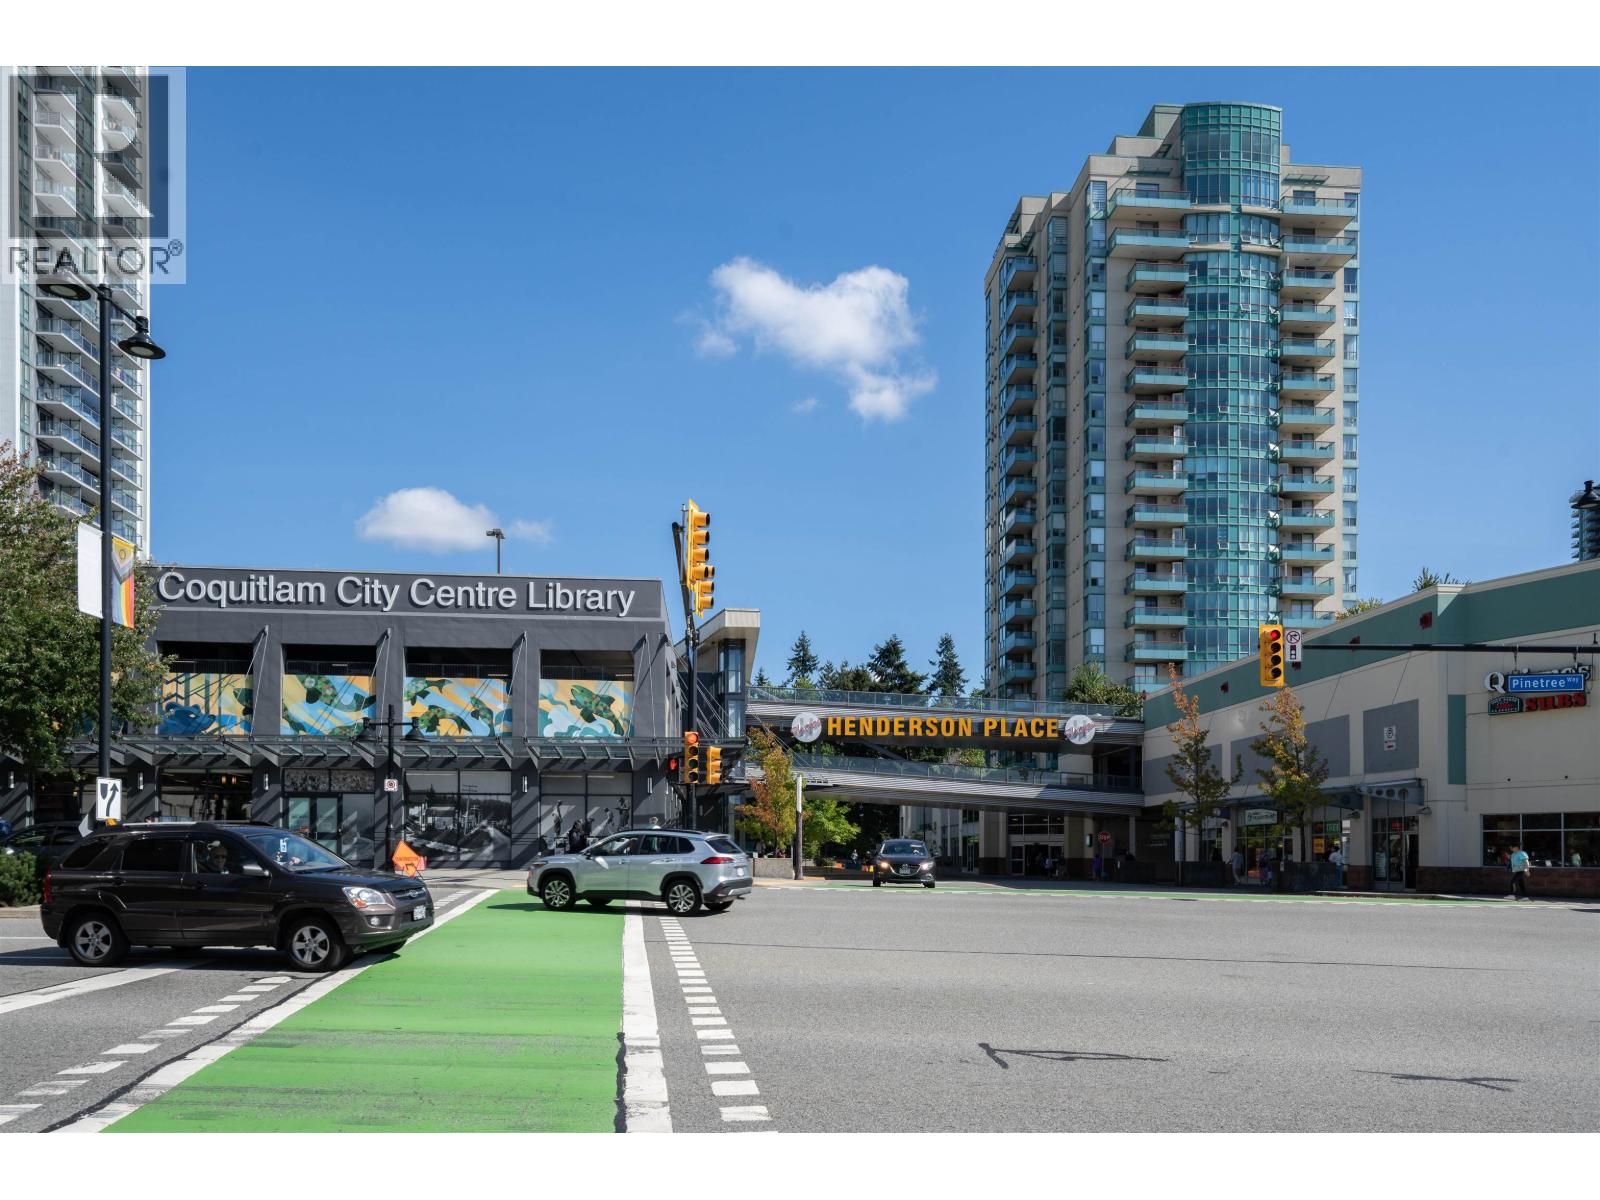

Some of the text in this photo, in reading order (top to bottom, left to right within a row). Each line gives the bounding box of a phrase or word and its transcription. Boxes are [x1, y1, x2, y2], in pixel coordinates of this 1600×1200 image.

[157, 571, 636, 617] Coquitlam City Centre Library
[1512, 677, 1566, 689] Pinetree
[1566, 676, 1580, 684] Way
[827, 715, 973, 738] HENDERSON
[983, 716, 1059, 738] PLACE
